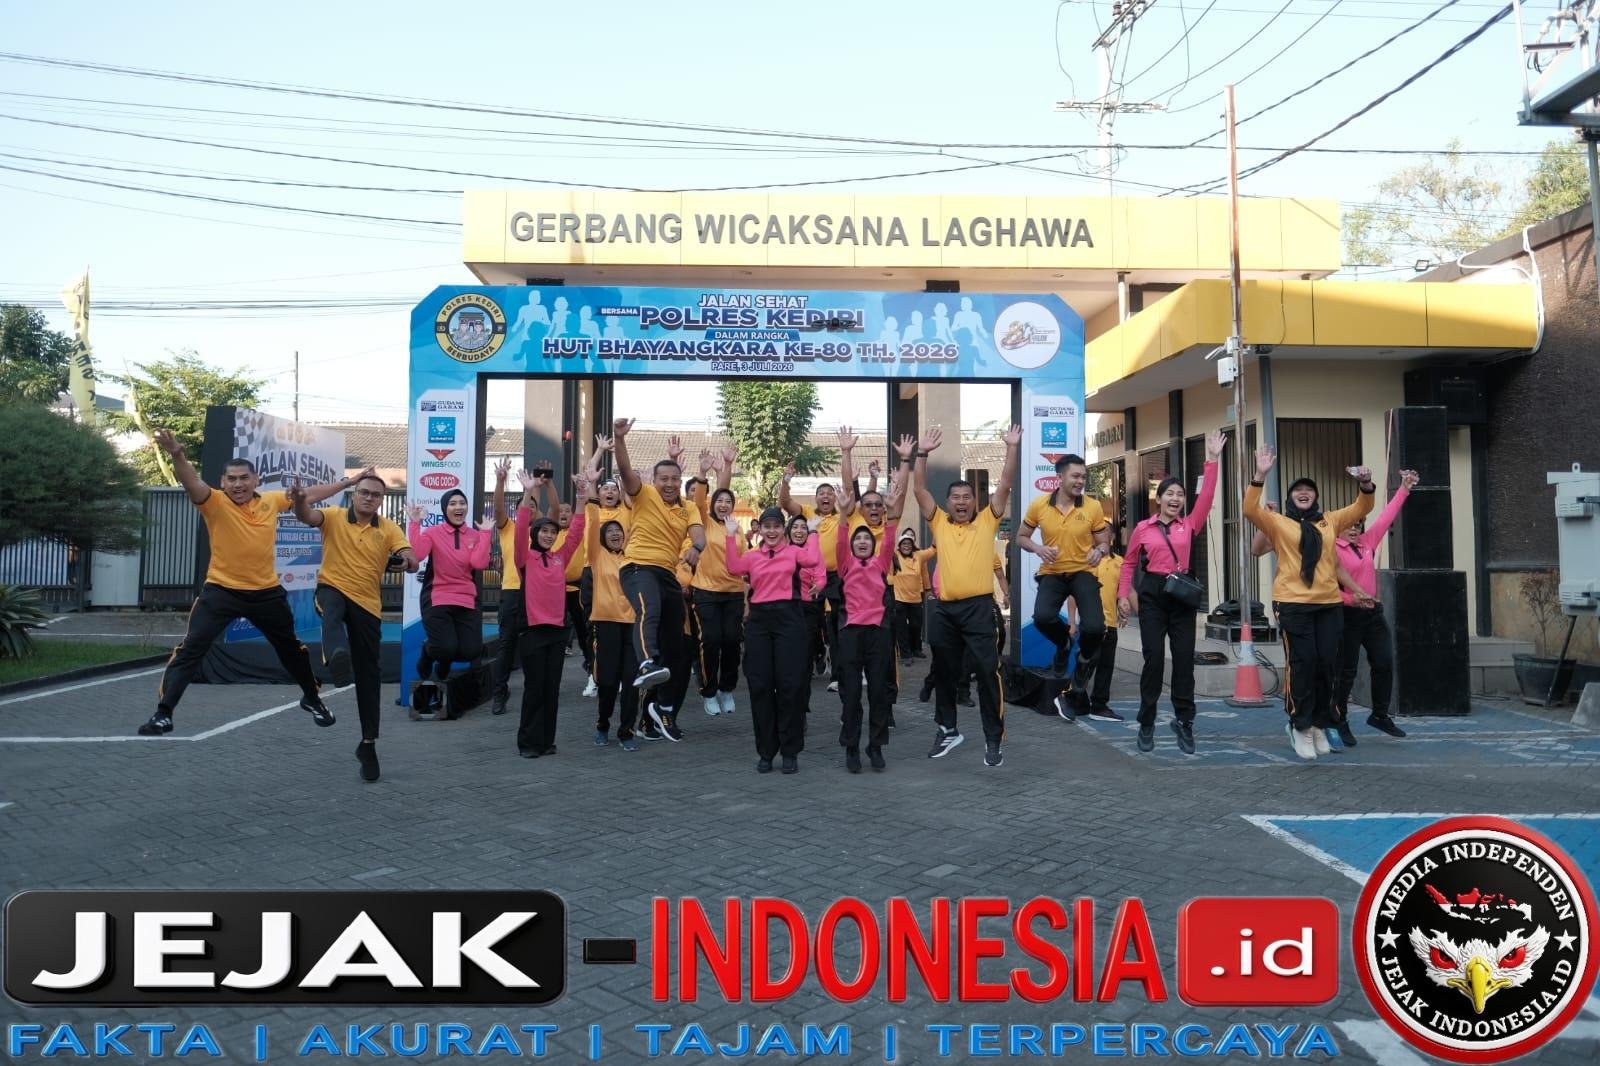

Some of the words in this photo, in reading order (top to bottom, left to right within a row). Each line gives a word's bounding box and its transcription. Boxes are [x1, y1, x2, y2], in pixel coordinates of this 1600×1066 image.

[510, 212, 683, 244] GERBANG
[695, 213, 909, 247] WICAKSANA
[922, 217, 1094, 248] LAGHAWA
[441, 295, 472, 316] POLRES
[475, 296, 502, 318] KEDIRI
[698, 294, 751, 308] JALAN
[755, 295, 808, 309] SEHAT
[600, 307, 639, 315] BERSAMA
[640, 305, 758, 330] POLRES
[766, 309, 865, 333] KEDIRI
[714, 331, 749, 340] DALAM
[751, 332, 790, 340] RANGKA
[446, 345, 496, 361] BERBUDAYA
[542, 337, 593, 358] HUT
[597, 338, 783, 362] BHAYANGKARA
[784, 342, 853, 362] KE-80
[856, 342, 896, 362] TH.
[899, 342, 960, 364] 2026
[711, 361, 740, 373] PARE,
[742, 362, 749, 372] 3
[749, 362, 770, 372] JULI
[771, 362, 795, 372] 2026
[255, 450, 297, 475] JALAN
[300, 453, 337, 485] SEHAT
[1035, 464, 1057, 472] WINGS
[424, 477, 440, 486] WONG
[441, 477, 455, 486] COCO
[1038, 479, 1054, 490] WONG
